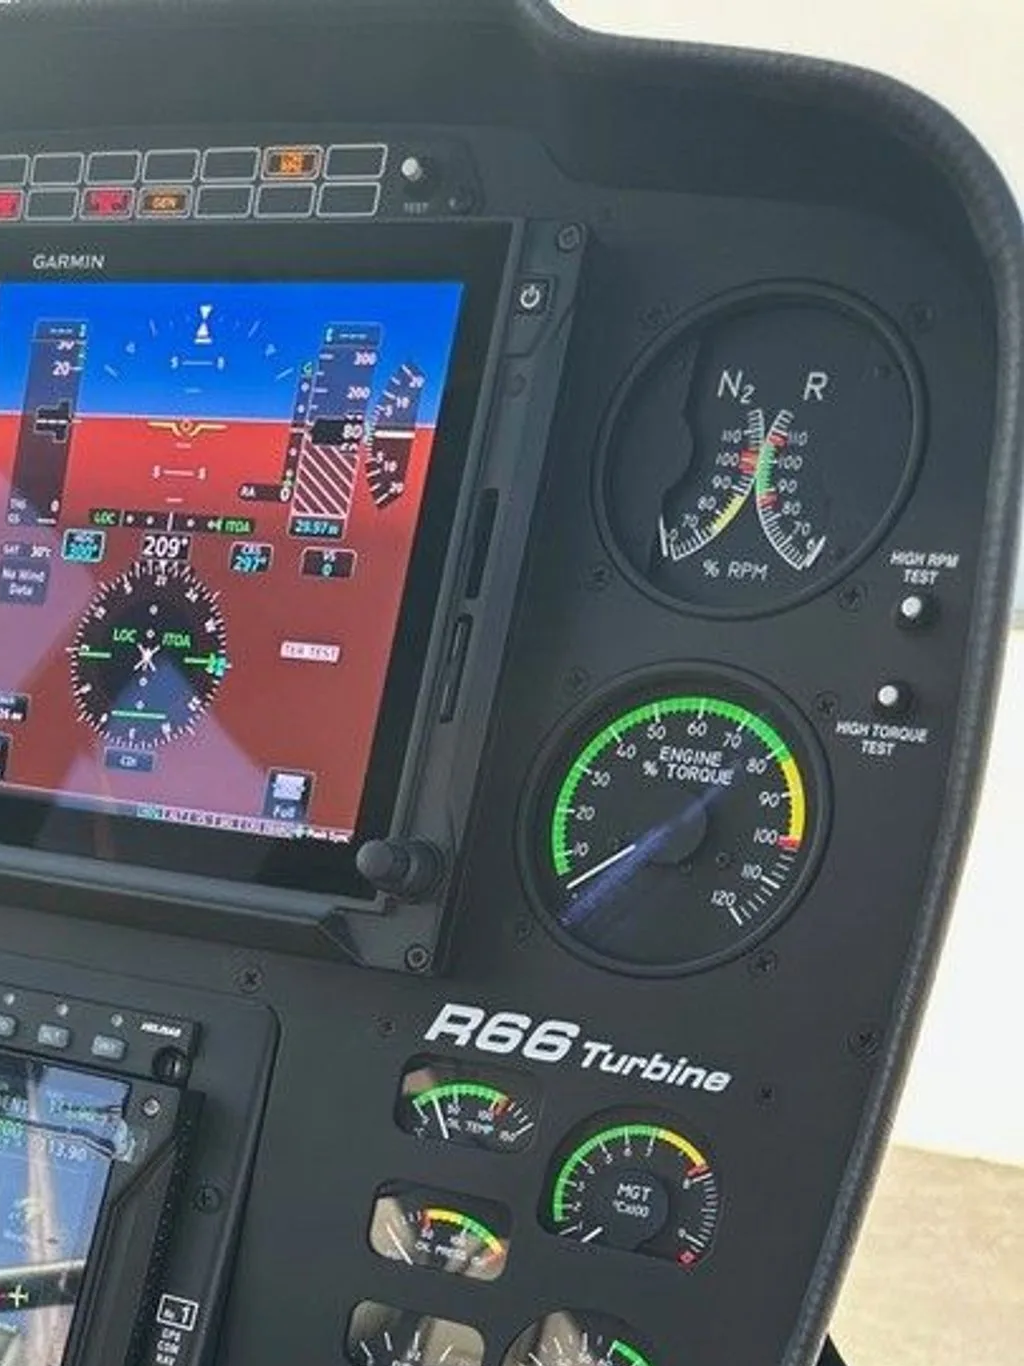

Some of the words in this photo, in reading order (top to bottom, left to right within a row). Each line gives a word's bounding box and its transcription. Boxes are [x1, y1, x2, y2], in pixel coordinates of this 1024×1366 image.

[32, 254, 105, 271] GARMIN
[52, 361, 71, 376] 20
[346, 386, 370, 400] 200
[803, 371, 828, 401] R
[342, 423, 363, 438] 80
[715, 453, 739, 467] 100
[778, 456, 803, 470] 100
[712, 475, 732, 490] 90
[778, 479, 798, 494] 90
[697, 496, 718, 512] 80
[782, 501, 802, 516] 80
[681, 514, 700, 529] 70
[794, 521, 812, 536] 70
[142, 536, 188, 557] 209°
[891, 549, 925, 567] HIGH
[927, 552, 960, 569] RPM
[702, 559, 720, 577] %
[728, 561, 768, 581] RPM
[903, 569, 940, 586] TEST
[112, 629, 137, 643] LOC
[647, 723, 667, 741] 50
[686, 720, 707, 738] 60
[835, 720, 871, 737] HIGH
[871, 723, 929, 744] TORQUE
[722, 732, 743, 750] 70
[860, 740, 895, 757] TEST
[616, 743, 637, 760] 40
[658, 745, 723, 767] ENGINE
[642, 761, 659, 777] %
[666, 761, 735, 787] TORQUE
[746, 757, 767, 776] 80
[591, 771, 611, 788] 30
[758, 791, 780, 809] 90
[575, 804, 596, 822] 20
[753, 828, 778, 845] 100
[741, 863, 763, 881] 110
[711, 889, 736, 908] 120
[424, 1002, 582, 1063] R66
[581, 1039, 733, 1092] Turbine
[615, 1183, 655, 1202] MGT
